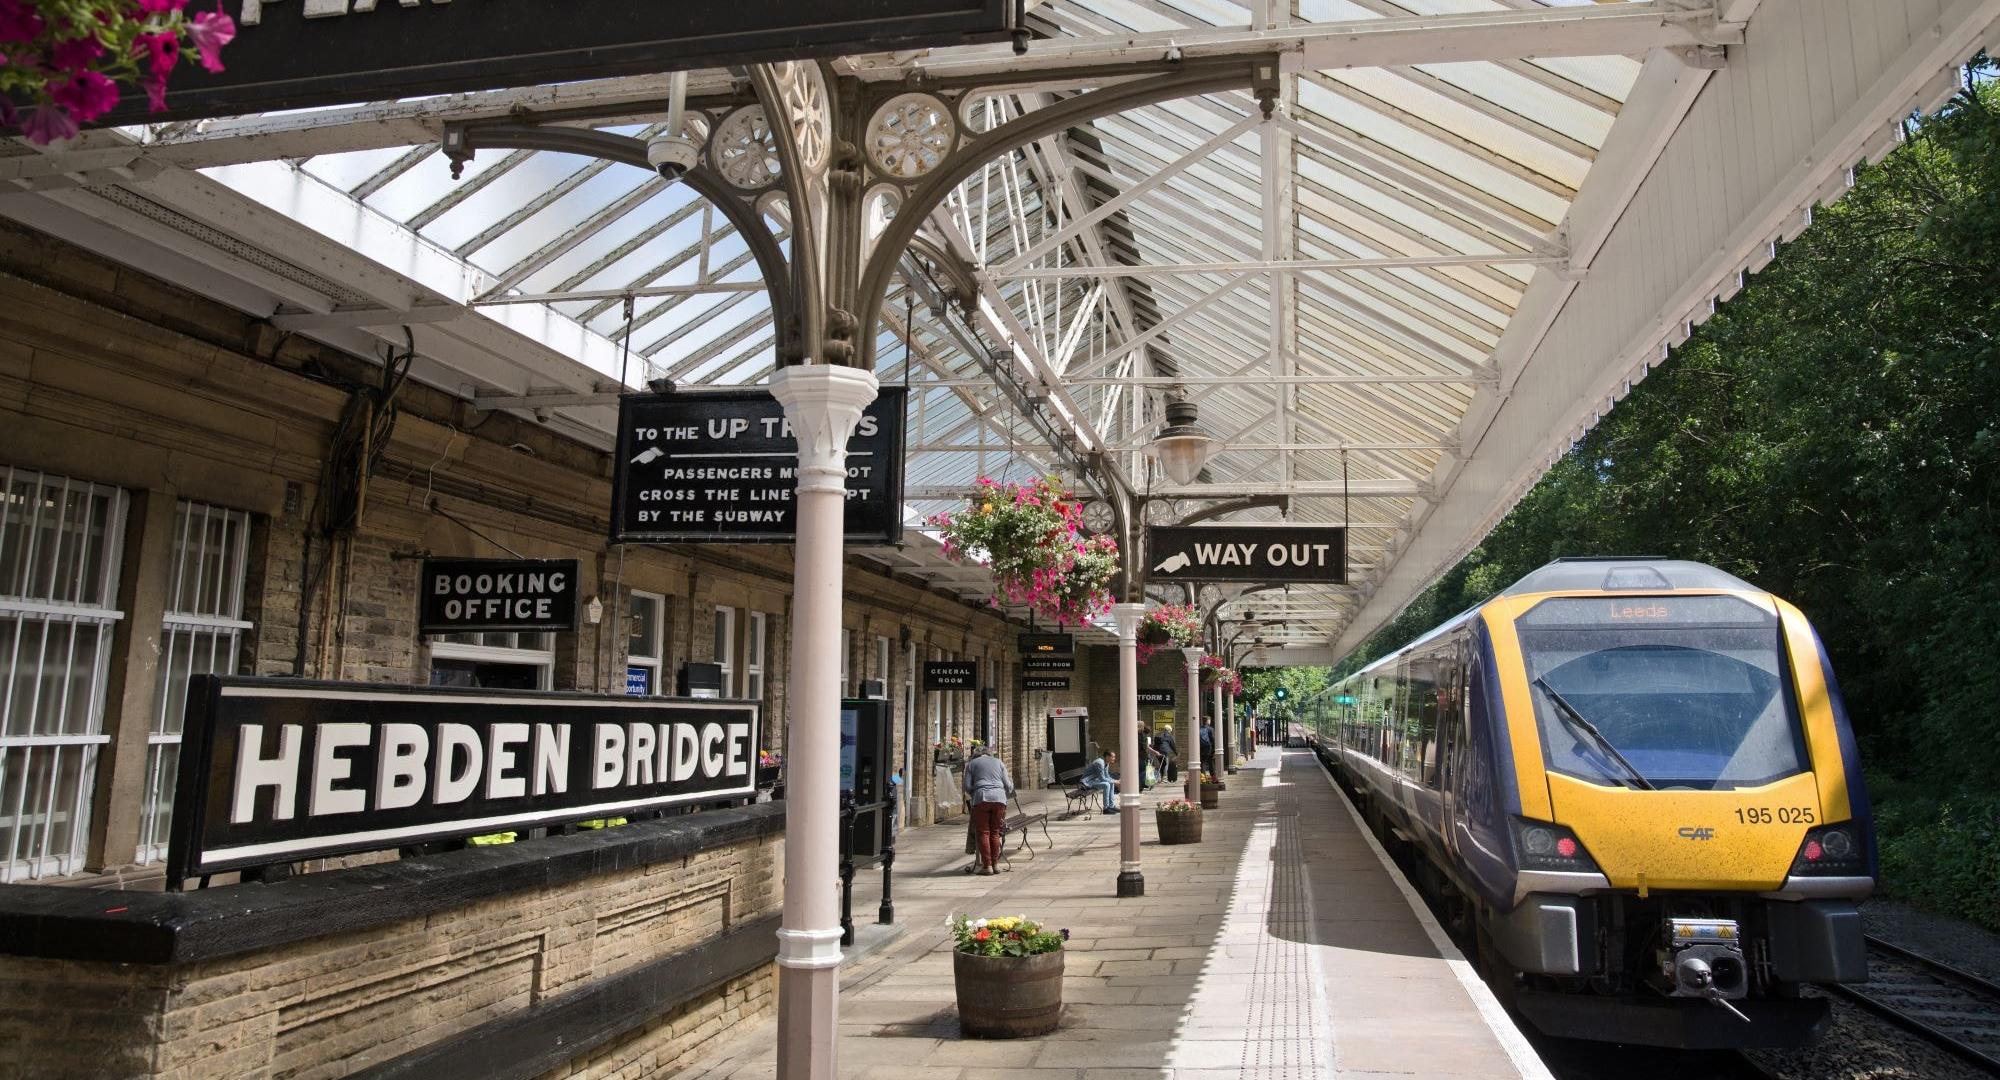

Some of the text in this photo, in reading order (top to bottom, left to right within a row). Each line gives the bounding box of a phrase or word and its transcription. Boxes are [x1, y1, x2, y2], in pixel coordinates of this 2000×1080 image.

[635, 415, 879, 441] TO THE UP TRS
[664, 467, 772, 480] PASSENGERS
[639, 488, 791, 501] CROSS THE LINE
[638, 510, 785, 522] BY THE SUBWAY
[1194, 543, 1330, 567] WAY OUT
[434, 572, 566, 595] BOOKING
[444, 598, 552, 620] OFFICE
[1610, 601, 1668, 618] Leeds
[231, 723, 748, 824] HEBDEN BRIDGE
[1734, 807, 1815, 824] 195 025
